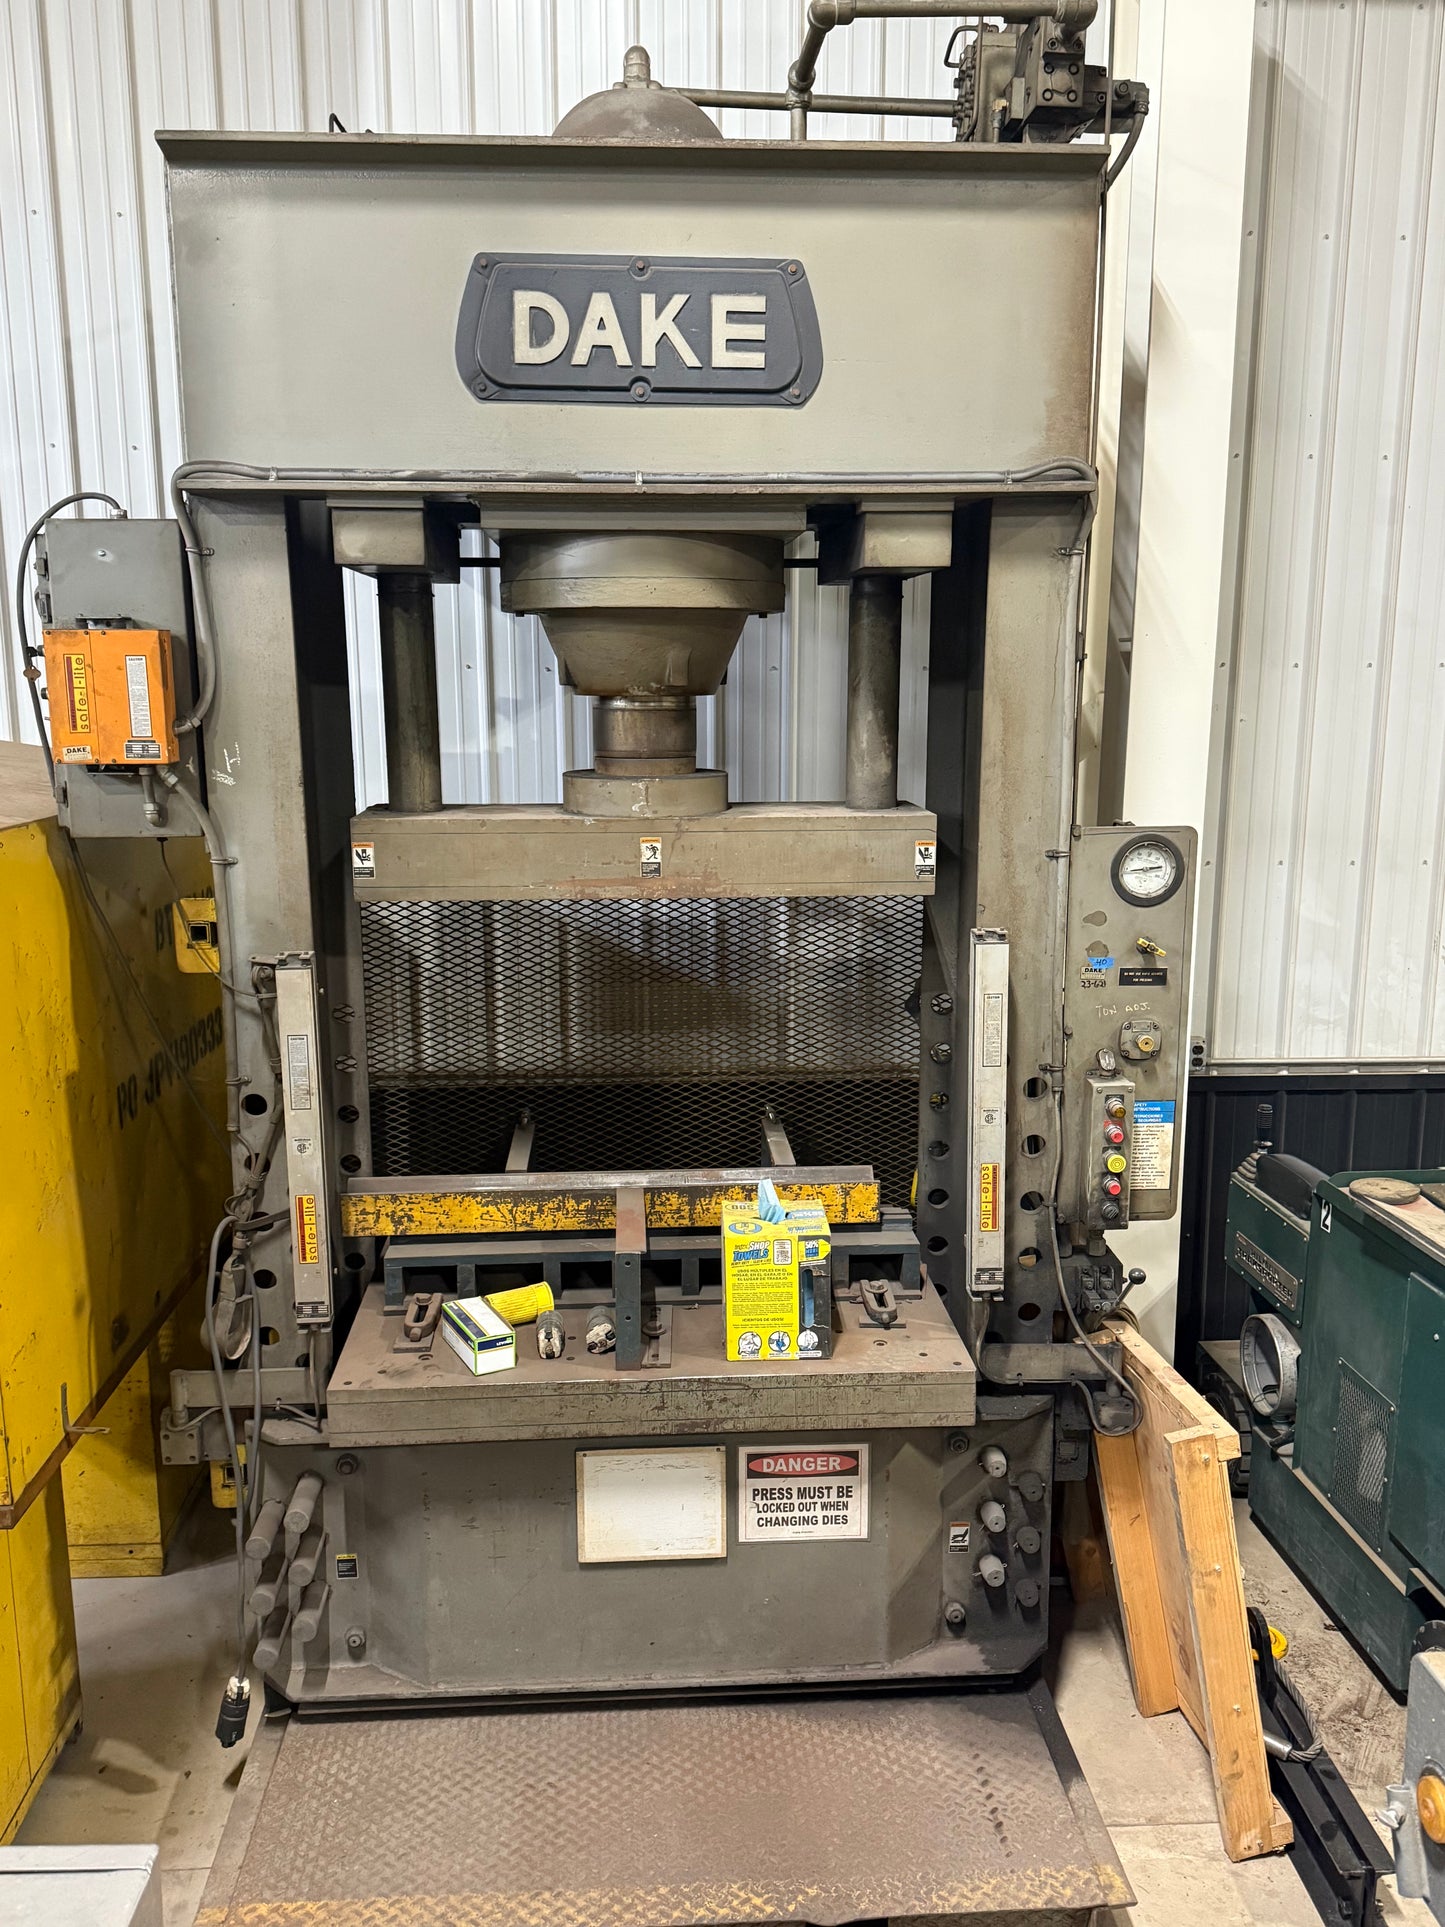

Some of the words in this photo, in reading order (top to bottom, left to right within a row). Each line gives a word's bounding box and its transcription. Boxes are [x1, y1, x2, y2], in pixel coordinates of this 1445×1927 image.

[512, 289, 767, 369] DAKE
[1095, 1005, 1117, 1018] TON
[1322, 1200, 1331, 1231] 2
[749, 1240, 771, 1251] SHOP
[733, 1249, 770, 1262] TOWELS
[762, 1456, 841, 1473] DANGER
[752, 1487, 793, 1501] PRESS
[797, 1486, 833, 1500] MUST
[836, 1485, 853, 1498] BE
[757, 1502, 795, 1513] LOCKED
[798, 1502, 818, 1512] OUT
[820, 1501, 849, 1511] WHEN
[757, 1515, 818, 1527] CHANGING
[822, 1514, 848, 1525] DIES
